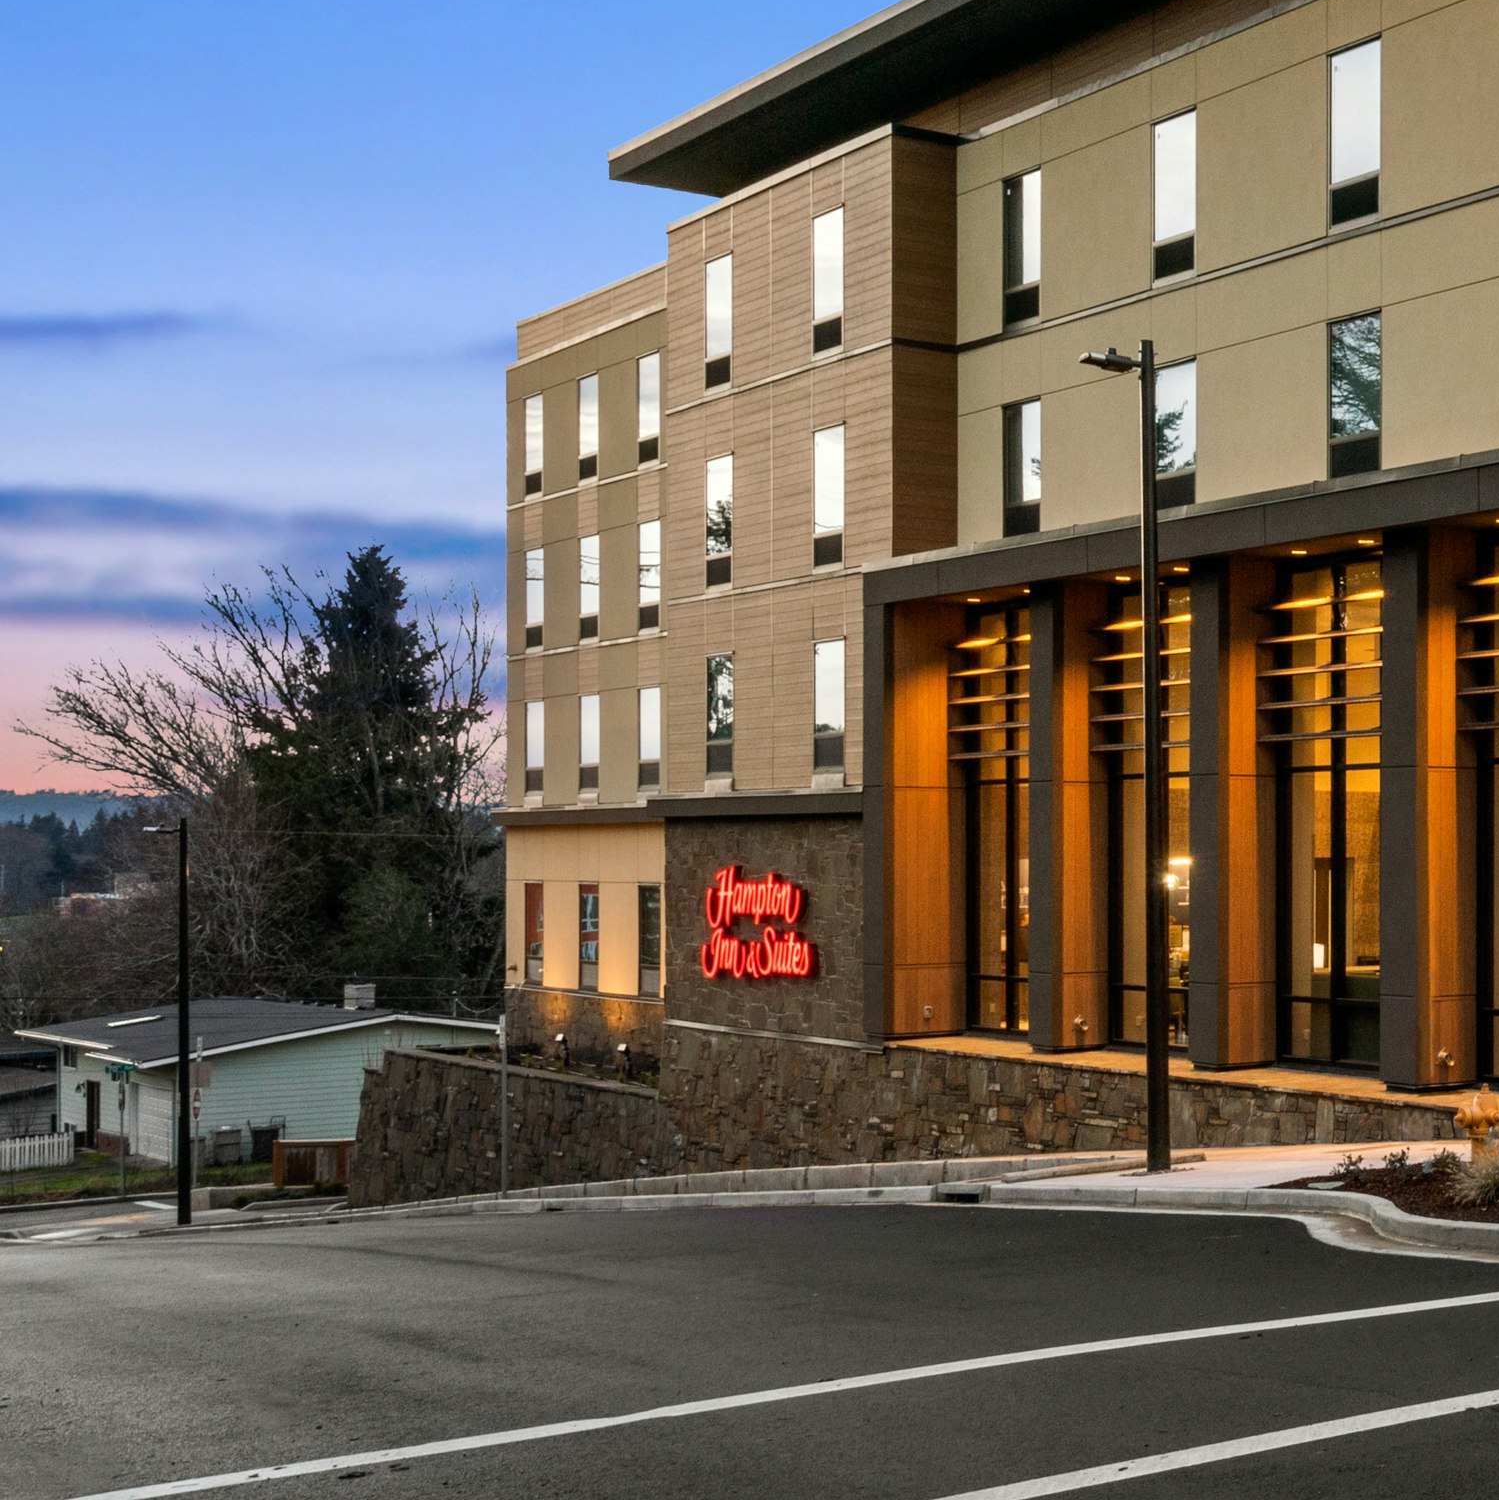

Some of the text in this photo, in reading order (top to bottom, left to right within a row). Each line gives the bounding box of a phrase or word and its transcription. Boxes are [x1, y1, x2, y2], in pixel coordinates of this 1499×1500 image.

[705, 864, 801, 929] Hampton
[701, 925, 810, 979] Inn & Suites
